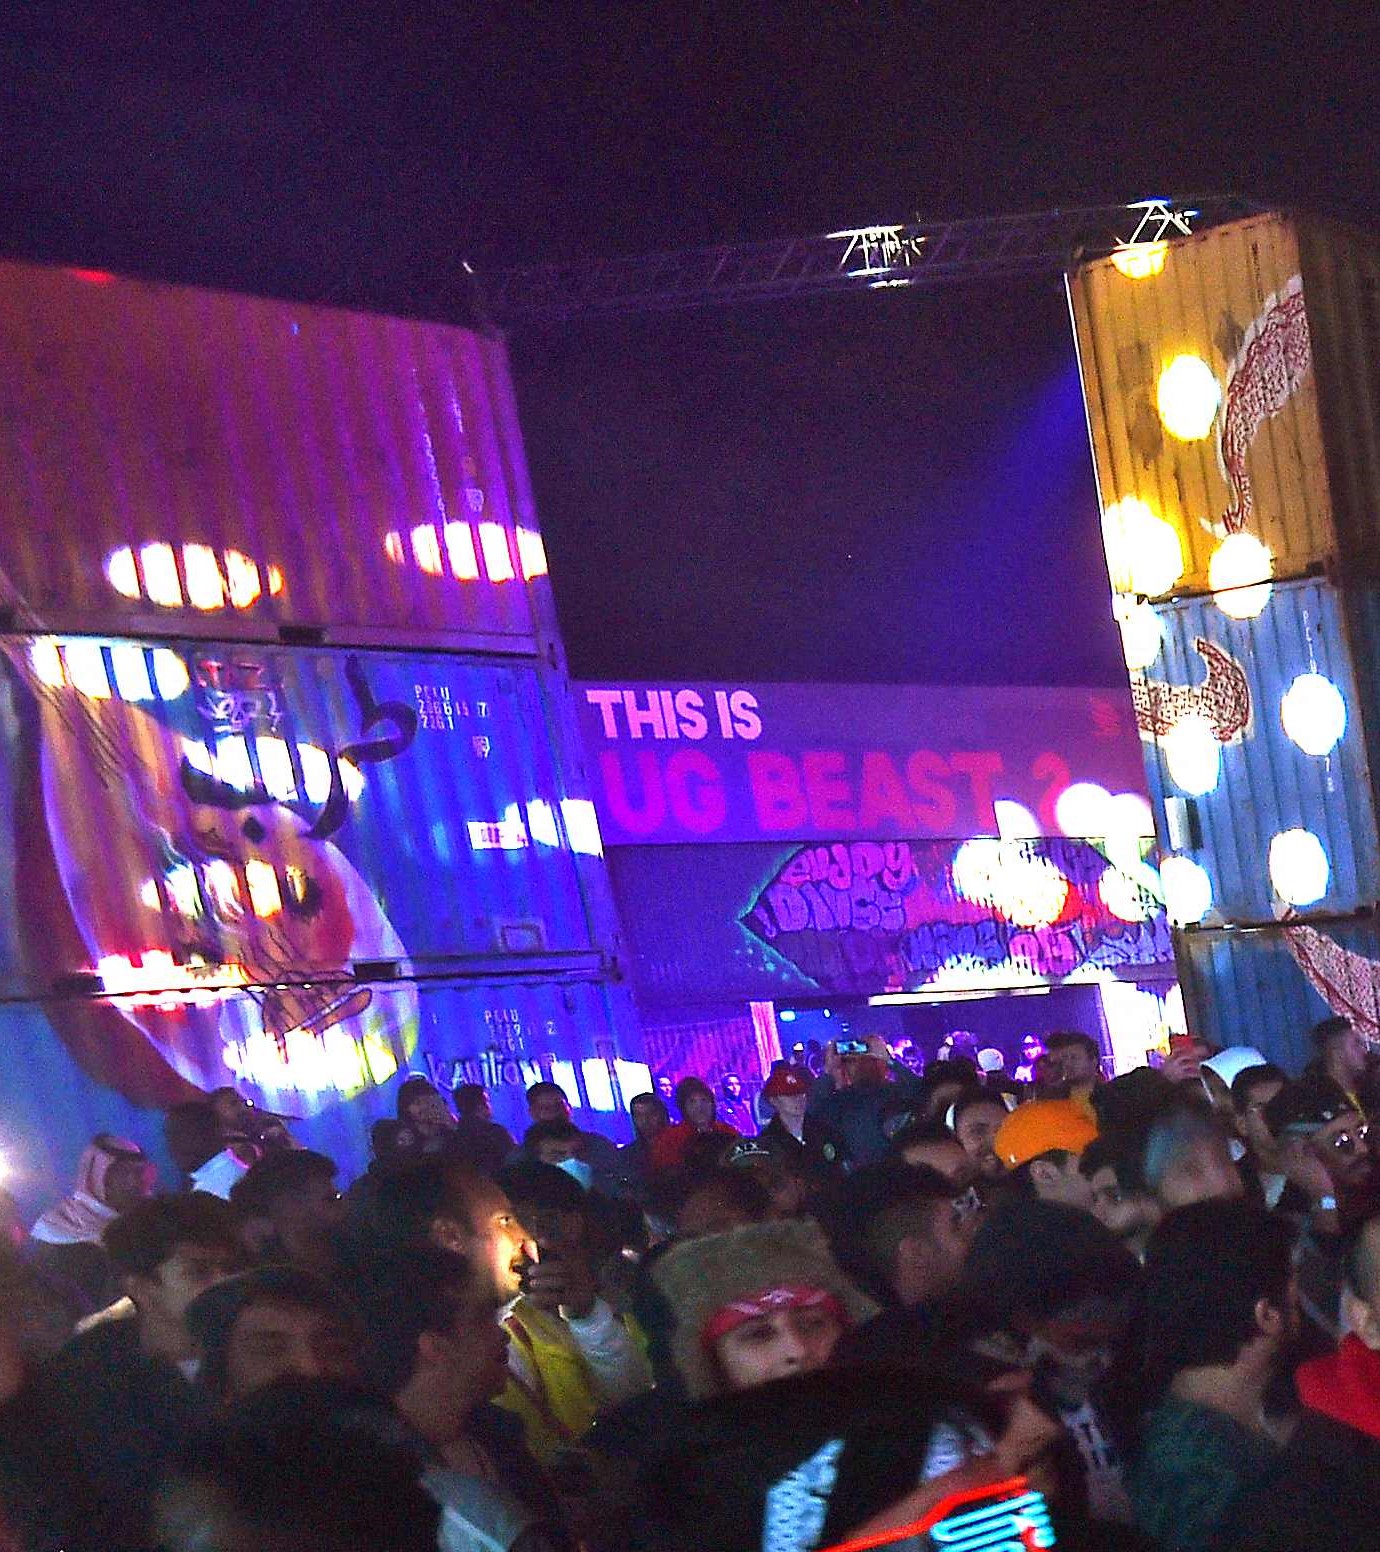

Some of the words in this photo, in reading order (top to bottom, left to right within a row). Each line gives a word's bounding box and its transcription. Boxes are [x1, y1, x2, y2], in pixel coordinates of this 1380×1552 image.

[586, 688, 707, 740] THIS
[718, 690, 762, 740] IS
[601, 750, 726, 836] UG
[746, 750, 1002, 832] BEAST
